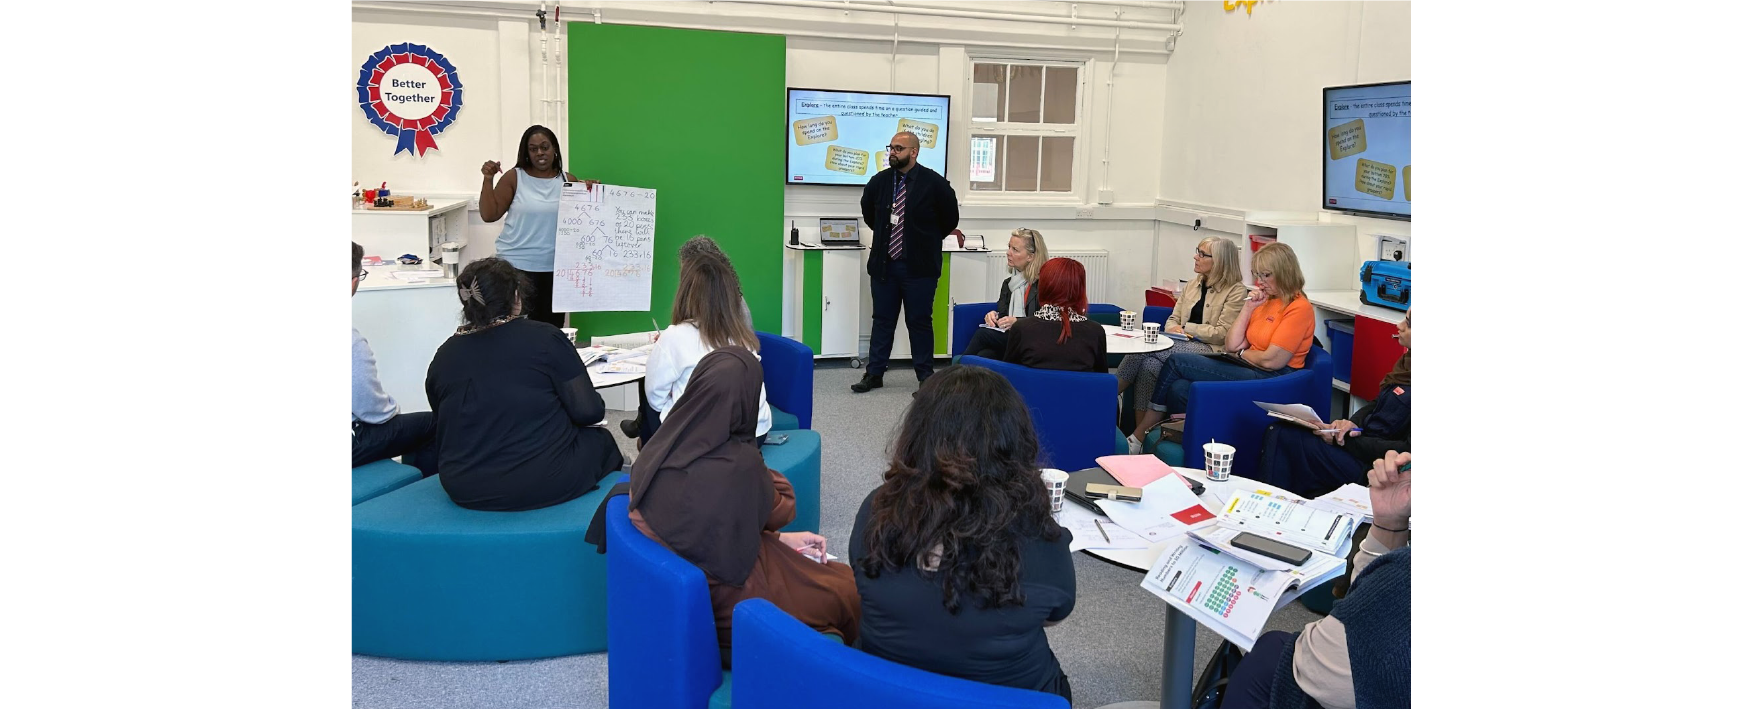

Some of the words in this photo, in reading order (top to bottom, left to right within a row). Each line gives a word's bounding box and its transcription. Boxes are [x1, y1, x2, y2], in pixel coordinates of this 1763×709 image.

[392, 78, 426, 88] Better
[384, 92, 436, 104] Together
[1340, 141, 1356, 152] Explore?
[610, 189, 635, 198] 4676
[615, 206, 625, 216] You
[624, 220, 634, 228] 20
[616, 240, 642, 249] leftover
[1155, 564, 1168, 580] Reading
[1171, 544, 1183, 557] Writing
[1160, 565, 1173, 582] Numbers
[1179, 545, 1188, 556] Million
